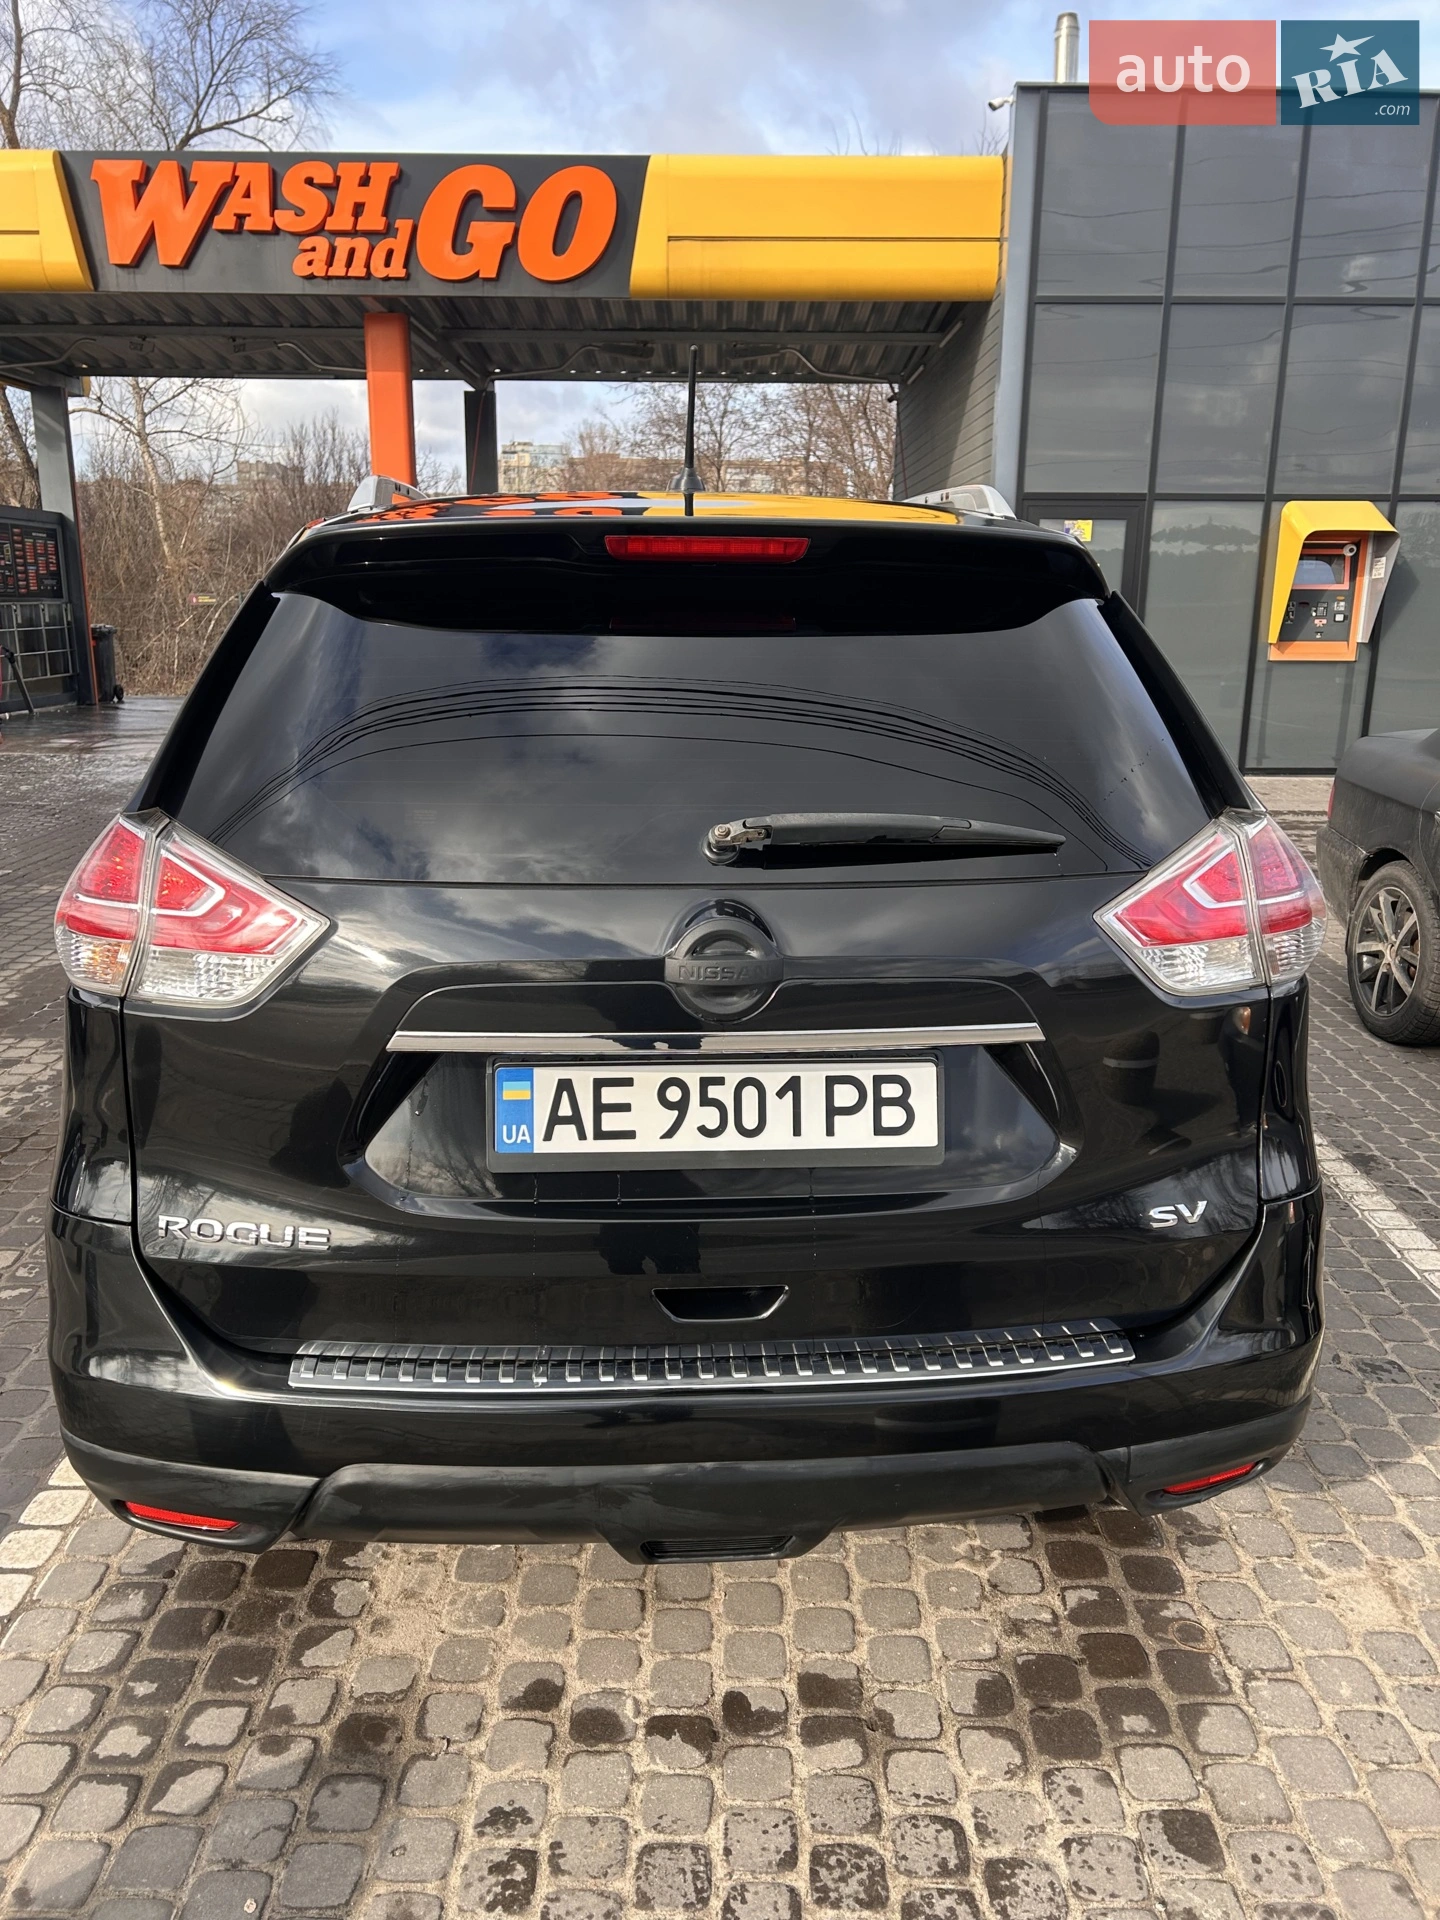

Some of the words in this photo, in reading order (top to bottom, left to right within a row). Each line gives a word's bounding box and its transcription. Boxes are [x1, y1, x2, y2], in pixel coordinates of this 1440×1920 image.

[90, 159, 400, 267] WASH
[292, 219, 414, 279] and
[415, 164, 618, 282] GO
[542, 1077, 636, 1142] AE
[657, 1075, 802, 1140] 9501
[825, 1074, 916, 1137] PB
[502, 1124, 532, 1144] UA
[158, 1214, 332, 1250] ROGUE
[1148, 1200, 1208, 1229] SV
